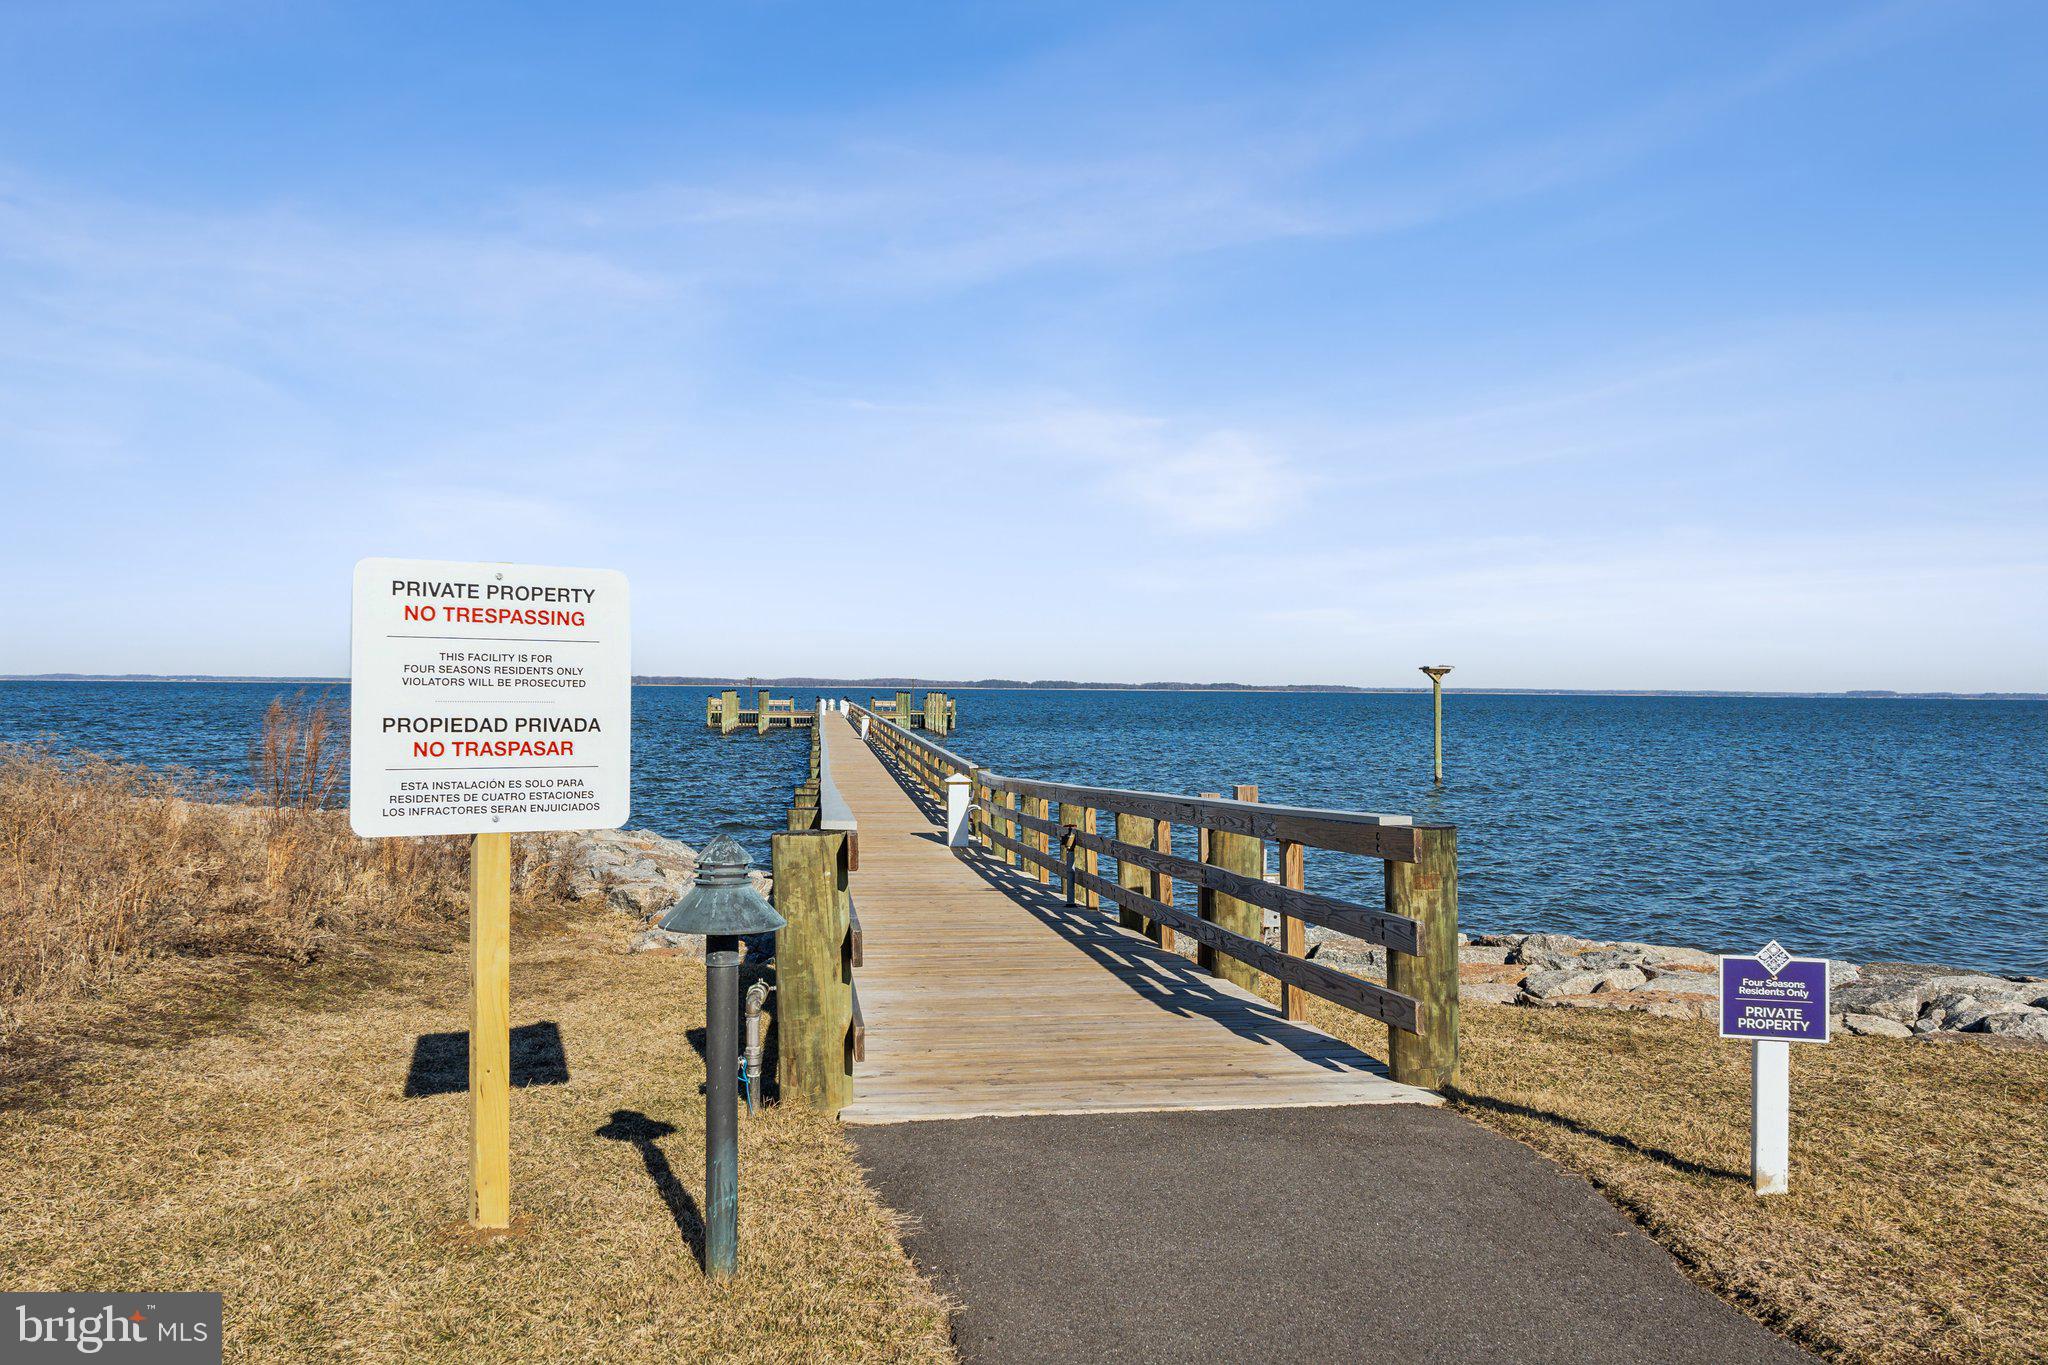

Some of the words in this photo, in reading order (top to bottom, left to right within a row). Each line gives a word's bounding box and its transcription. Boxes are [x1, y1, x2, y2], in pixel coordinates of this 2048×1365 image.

[392, 581, 479, 599] PRIVATE
[487, 584, 595, 603] PROPERTY
[404, 606, 436, 621] NO
[443, 607, 585, 626] TRESPASSING
[440, 653, 464, 661] THIS
[468, 653, 514, 662] FACILITY
[518, 654, 528, 662] IS
[531, 654, 552, 663] FOR
[404, 665, 435, 674] FOUR
[438, 665, 490, 674] SEASONS
[494, 666, 554, 675] RESIDENTS
[557, 667, 583, 676] ONLY
[402, 677, 465, 686] VIOLATORS
[468, 678, 494, 687] WILL
[497, 678, 511, 687] BE
[515, 679, 586, 688] PROSECUTED
[383, 718, 508, 733] PROPIEDAD
[515, 718, 601, 732] PRIVADA
[414, 742, 445, 757] NO
[452, 741, 573, 756] TRASPASAR
[401, 782, 429, 790] ESTA
[432, 778, 505, 790] INSTALACIÓN
[509, 780, 522, 789] ES
[525, 779, 554, 789] SOLO
[557, 779, 584, 788] PARA
[389, 794, 460, 803] RESIDENTES
[464, 793, 478, 802] DE
[482, 792, 526, 802] CUATRO
[529, 791, 594, 800] ESTACIONES
[382, 808, 405, 817] LOS
[409, 805, 487, 816] INFRACTORES
[491, 804, 526, 814] SERAN
[530, 803, 600, 812] ENJUICIADOS
[1743, 978, 1764, 986] Four
[1765, 979, 1805, 988] Seasons
[1739, 987, 1785, 996] Residents
[1787, 989, 1809, 998] Only
[1746, 1007, 1802, 1019] PRIVATE
[1738, 1018, 1809, 1031] PROPERTY
